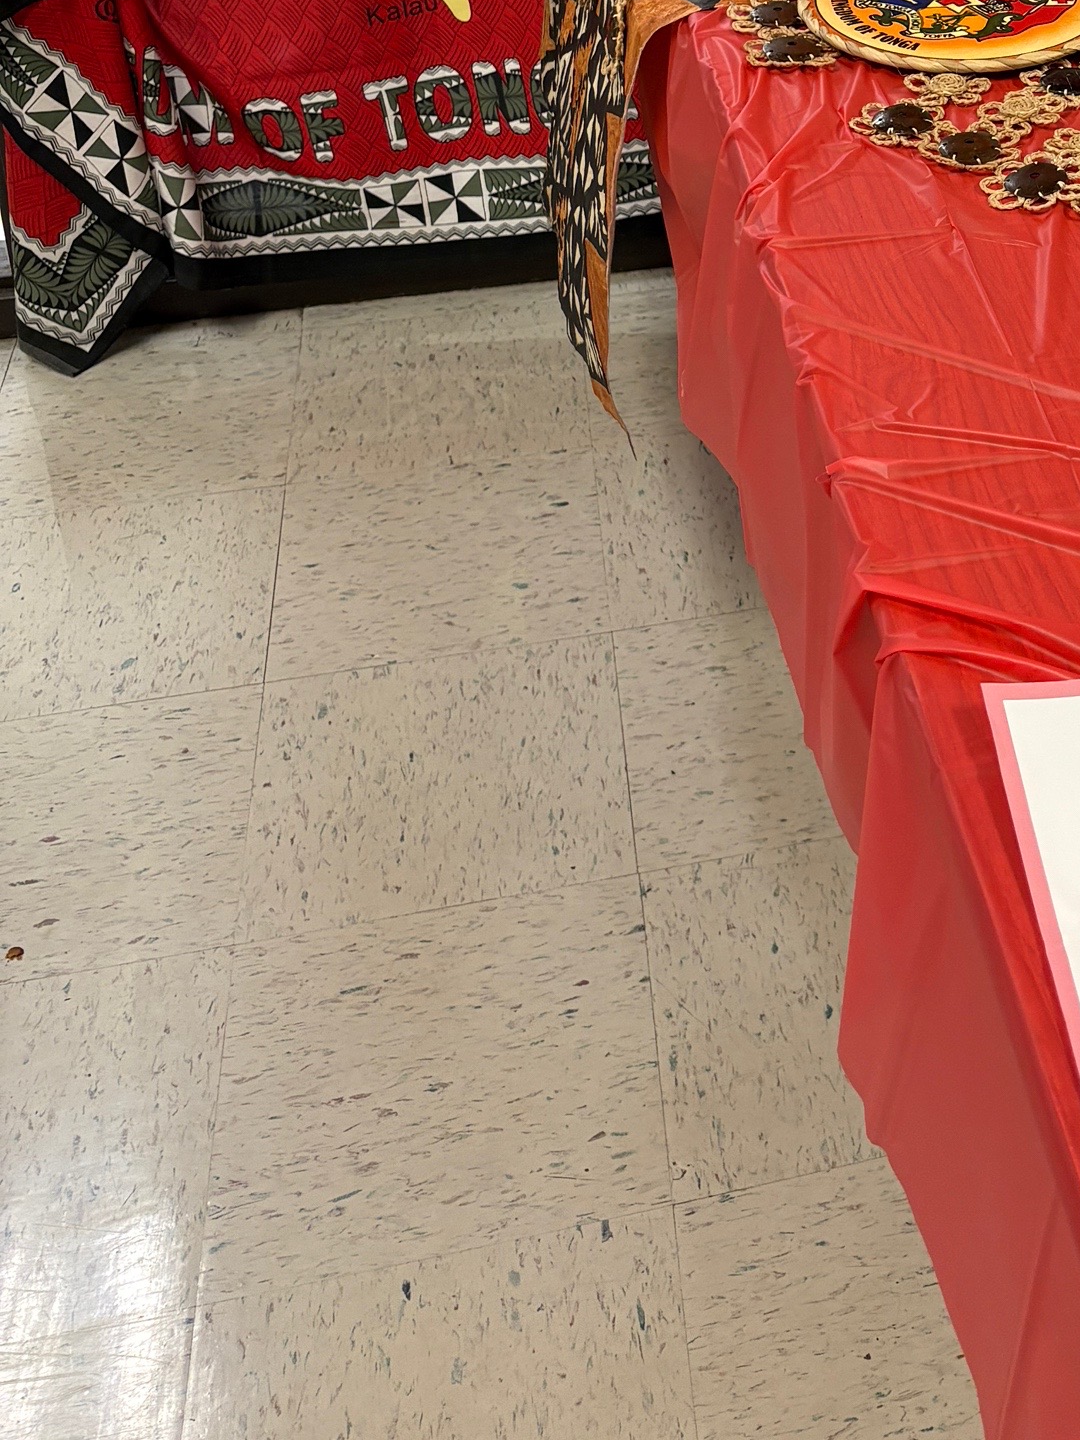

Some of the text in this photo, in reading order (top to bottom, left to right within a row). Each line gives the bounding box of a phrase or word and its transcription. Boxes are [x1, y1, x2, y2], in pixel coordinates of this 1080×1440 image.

[854, 24, 874, 38] OF
[872, 30, 922, 52] TONGA
[243, 89, 346, 163] OF
